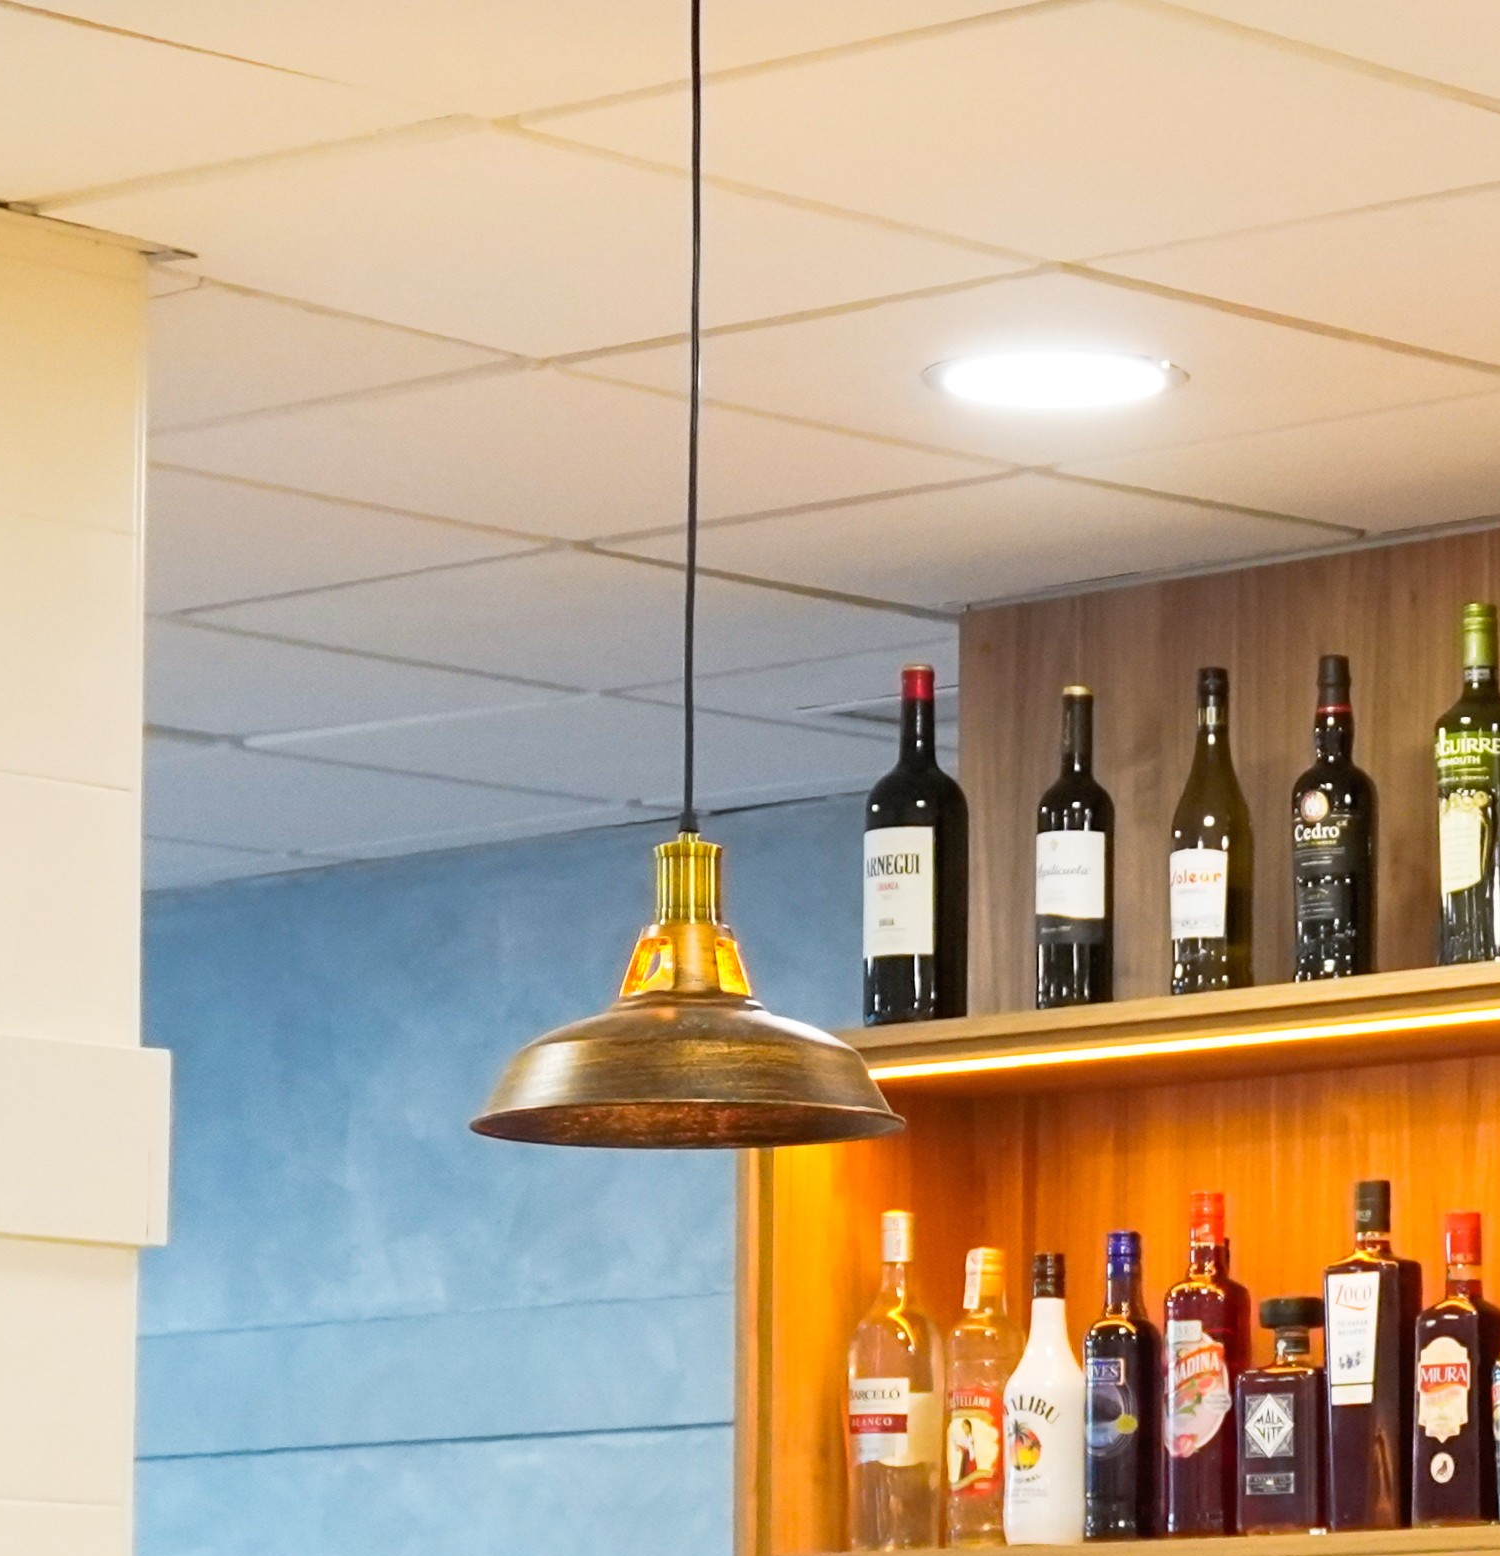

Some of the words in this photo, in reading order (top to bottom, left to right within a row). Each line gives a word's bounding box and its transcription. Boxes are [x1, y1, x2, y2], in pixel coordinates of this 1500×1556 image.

[1295, 822, 1340, 842] Cedro
[1088, 1363, 1119, 1378] IVES
[1421, 1366, 1467, 1384] MIURA
[950, 1395, 991, 1409] STELLANA
